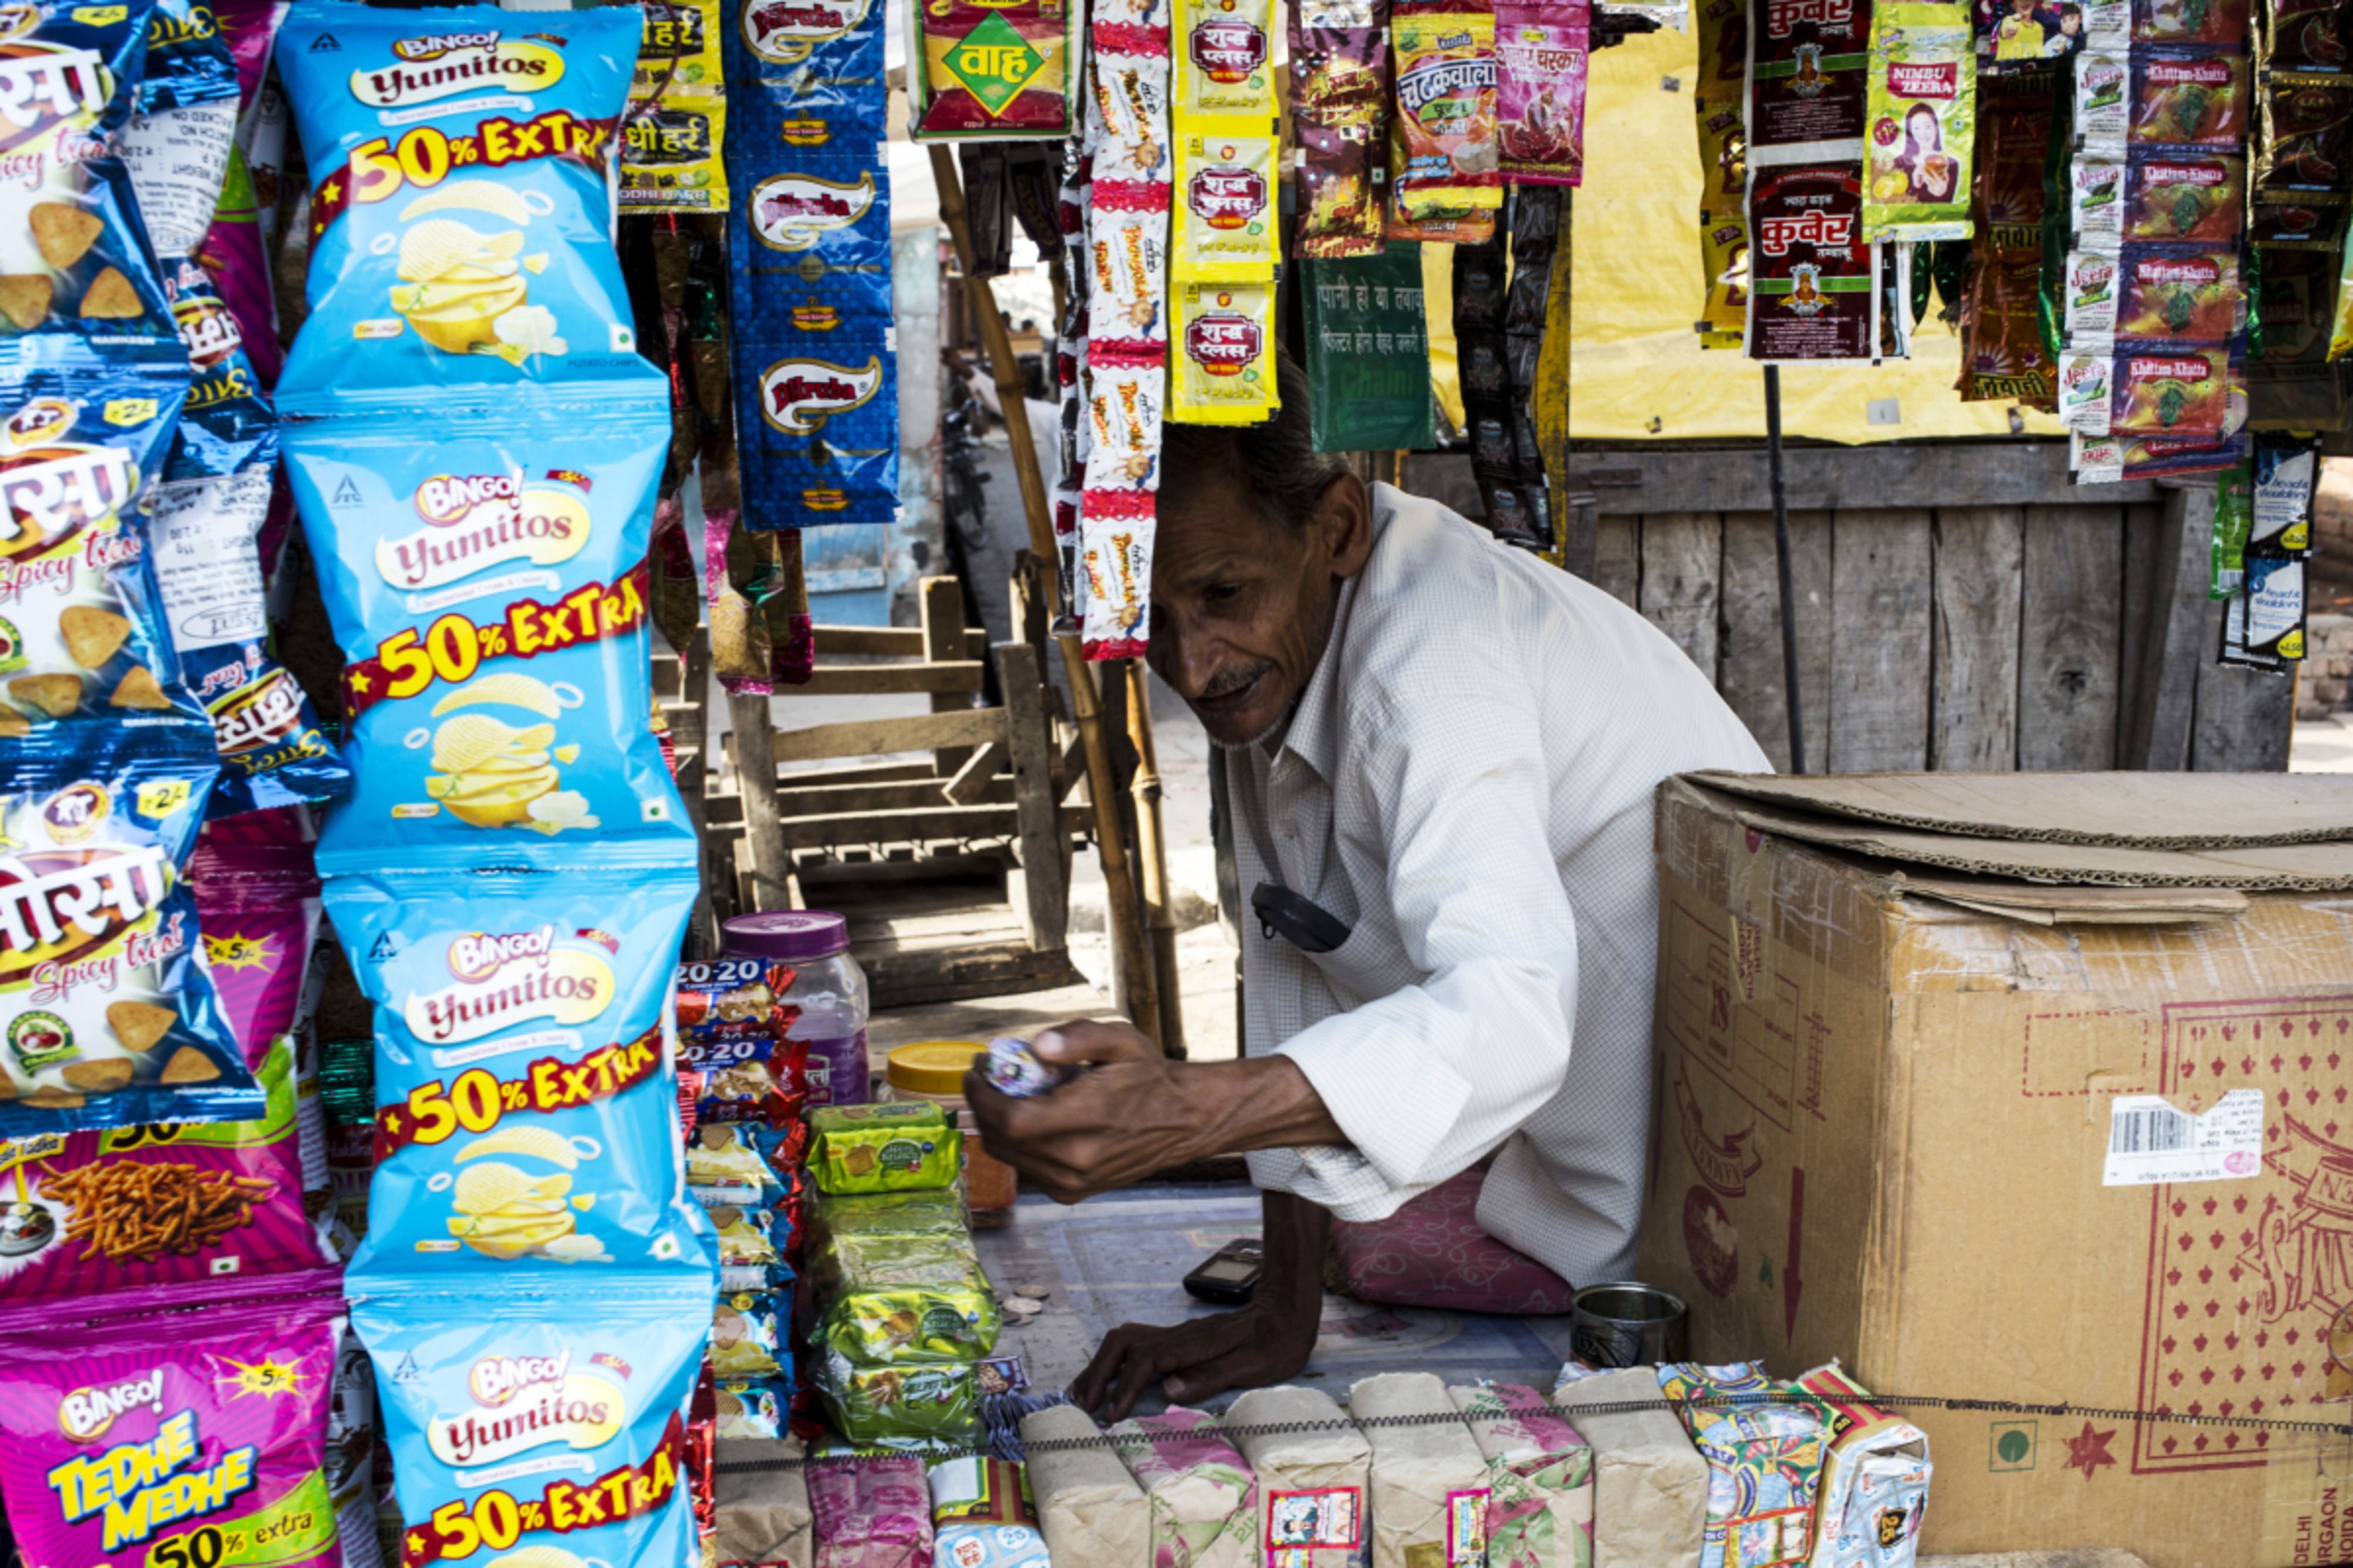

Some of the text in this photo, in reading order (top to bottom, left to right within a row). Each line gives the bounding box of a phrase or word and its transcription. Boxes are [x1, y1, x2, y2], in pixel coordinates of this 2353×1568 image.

[400, 30, 502, 58] BINGO!
[959, 45, 1029, 84] वाह
[369, 52, 547, 104] Yumitos
[1893, 67, 1947, 80] NIMBU
[348, 114, 612, 203] 50% EXTRA
[1761, 209, 1855, 257] कुबेर
[770, 375, 857, 416] Dilruba
[422, 467, 525, 518] BINGO!
[395, 515, 572, 585] Yumitos
[378, 577, 645, 698] 50% EXTRA
[455, 922, 555, 974] BINGO!
[29, 955, 119, 1003] Spicy
[425, 971, 598, 1037] Yumitos
[686, 1041, 756, 1060] 0-20
[408, 1039, 655, 1145] 50% EXTRA
[473, 1349, 572, 1400] BINGO!
[65, 1368, 164, 1436] BINGO!
[446, 1398, 609, 1462] Yumitos
[48, 1410, 198, 1523] TEDHE
[103, 1446, 256, 1553] MEDHE
[432, 1449, 676, 1560] 50% EXTRA
[2316, 1487, 2337, 1566] URGAON
[153, 1511, 313, 1568] 50% extra
[2295, 1515, 2313, 1566] DELHI
